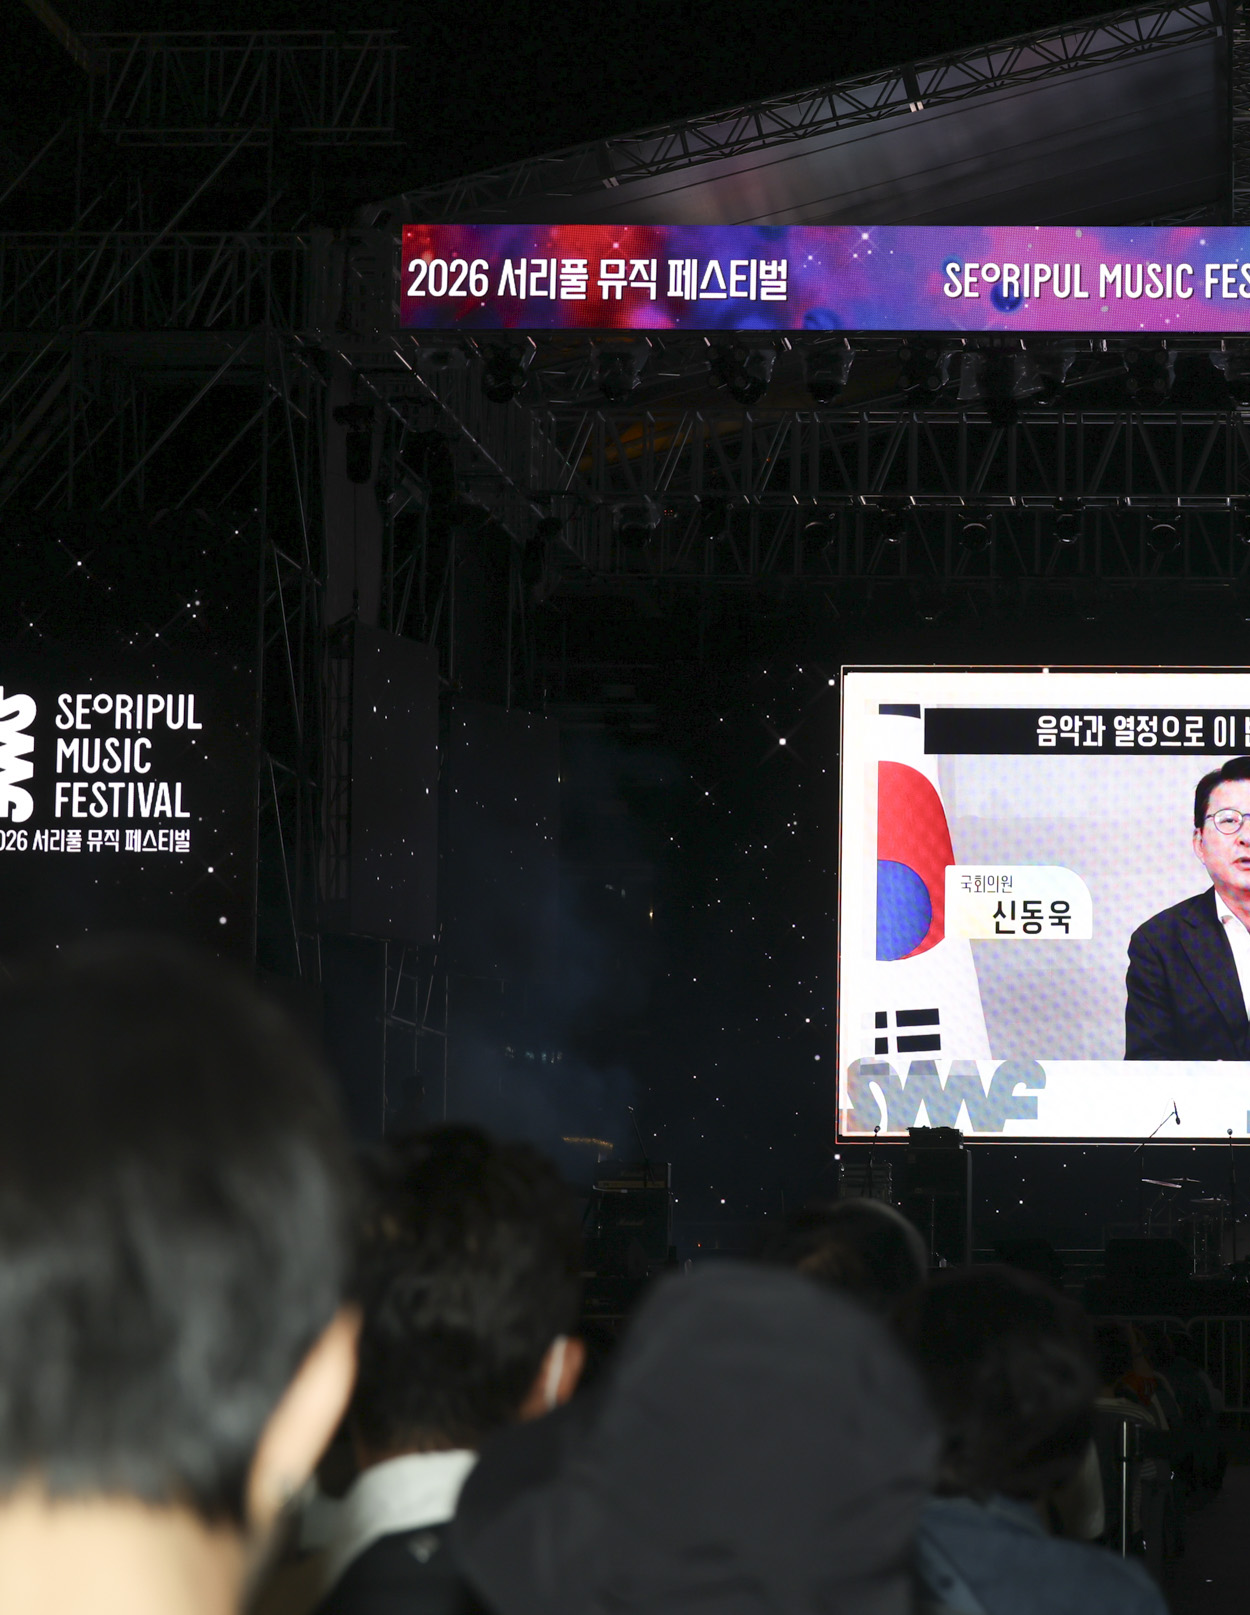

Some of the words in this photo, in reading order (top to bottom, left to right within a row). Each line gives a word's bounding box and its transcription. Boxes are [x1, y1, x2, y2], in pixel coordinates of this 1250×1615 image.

[407, 259, 489, 297] 2026
[498, 258, 588, 300] 서리풀
[597, 258, 657, 300] 뮤직
[667, 258, 787, 301] 페스티벌
[943, 262, 1089, 299] SEORIPUL
[1099, 262, 1193, 299] MUSIC
[55, 693, 203, 730] SEORIPUL
[1036, 715, 1107, 747] 음악과
[1113, 715, 1205, 747] 열정으로
[1213, 715, 1236, 748] 이
[56, 737, 152, 774] MUSIC
[54, 781, 191, 818] FESTIVAL
[32, 829, 82, 852] 서리풀
[87, 829, 120, 852] 뮤직
[125, 829, 190, 852] 페스티벌
[960, 875, 1013, 893] 국회의원
[992, 900, 1072, 935] 신동욱
